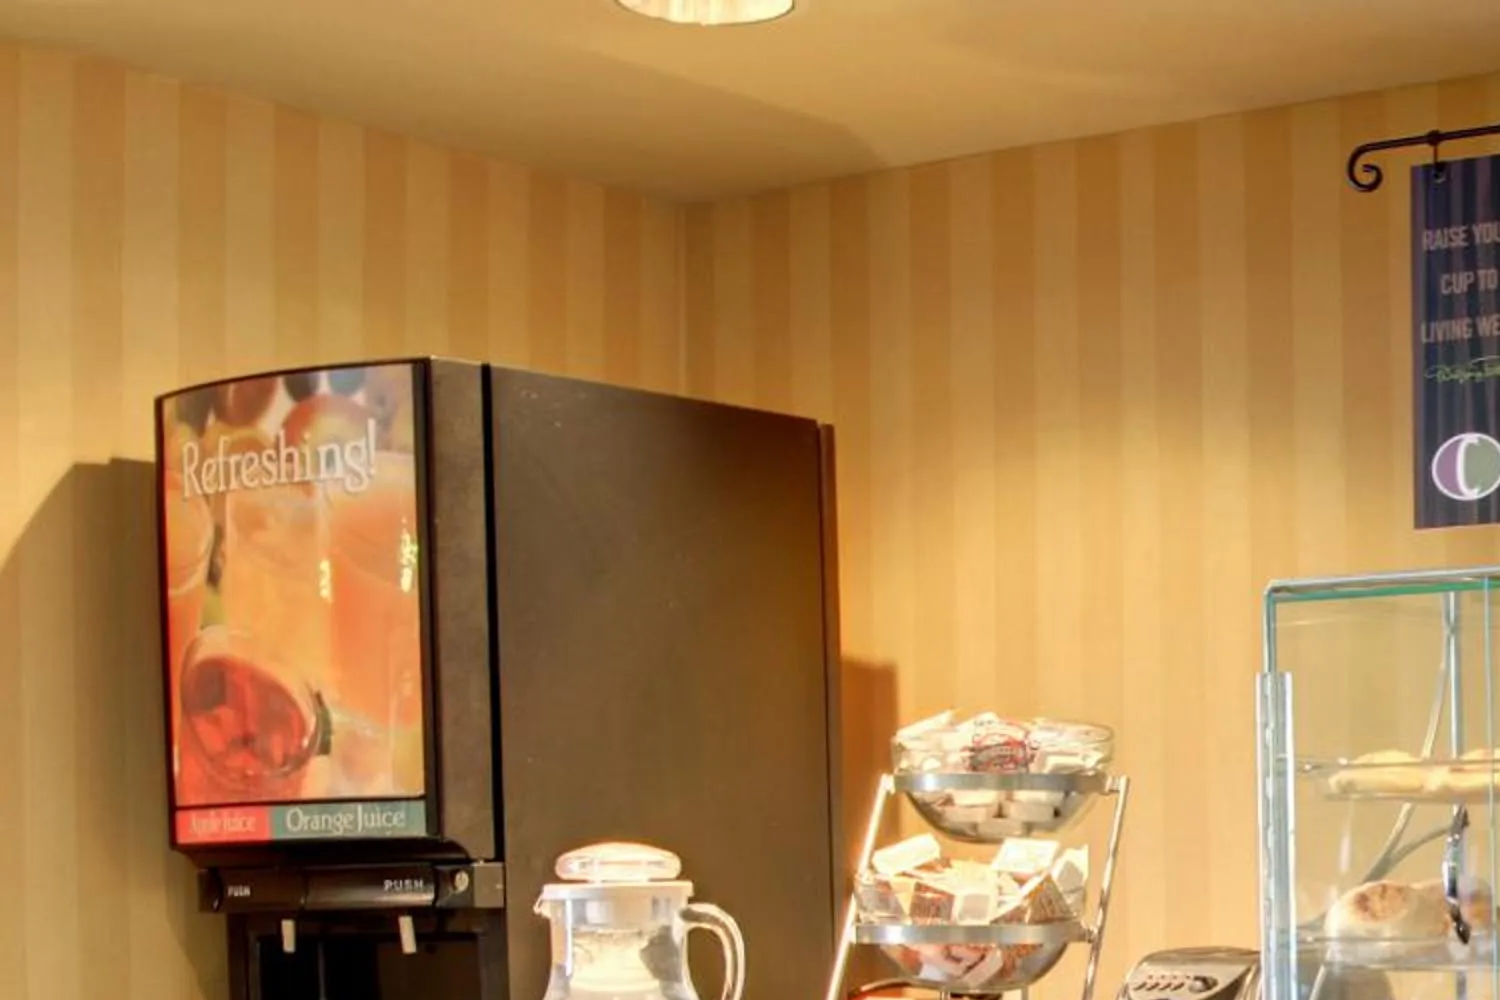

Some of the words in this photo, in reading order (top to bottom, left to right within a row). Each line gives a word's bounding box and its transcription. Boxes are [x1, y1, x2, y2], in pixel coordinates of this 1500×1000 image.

[1422, 227, 1469, 251] RAISE
[1441, 272, 1474, 295] CUP
[1479, 269, 1498, 291] TO
[1420, 317, 1473, 344] LIVING
[182, 417, 376, 498] Refreshing!
[286, 808, 354, 833] Orange
[357, 805, 406, 832] Juice
[383, 878, 424, 892] PUSH
